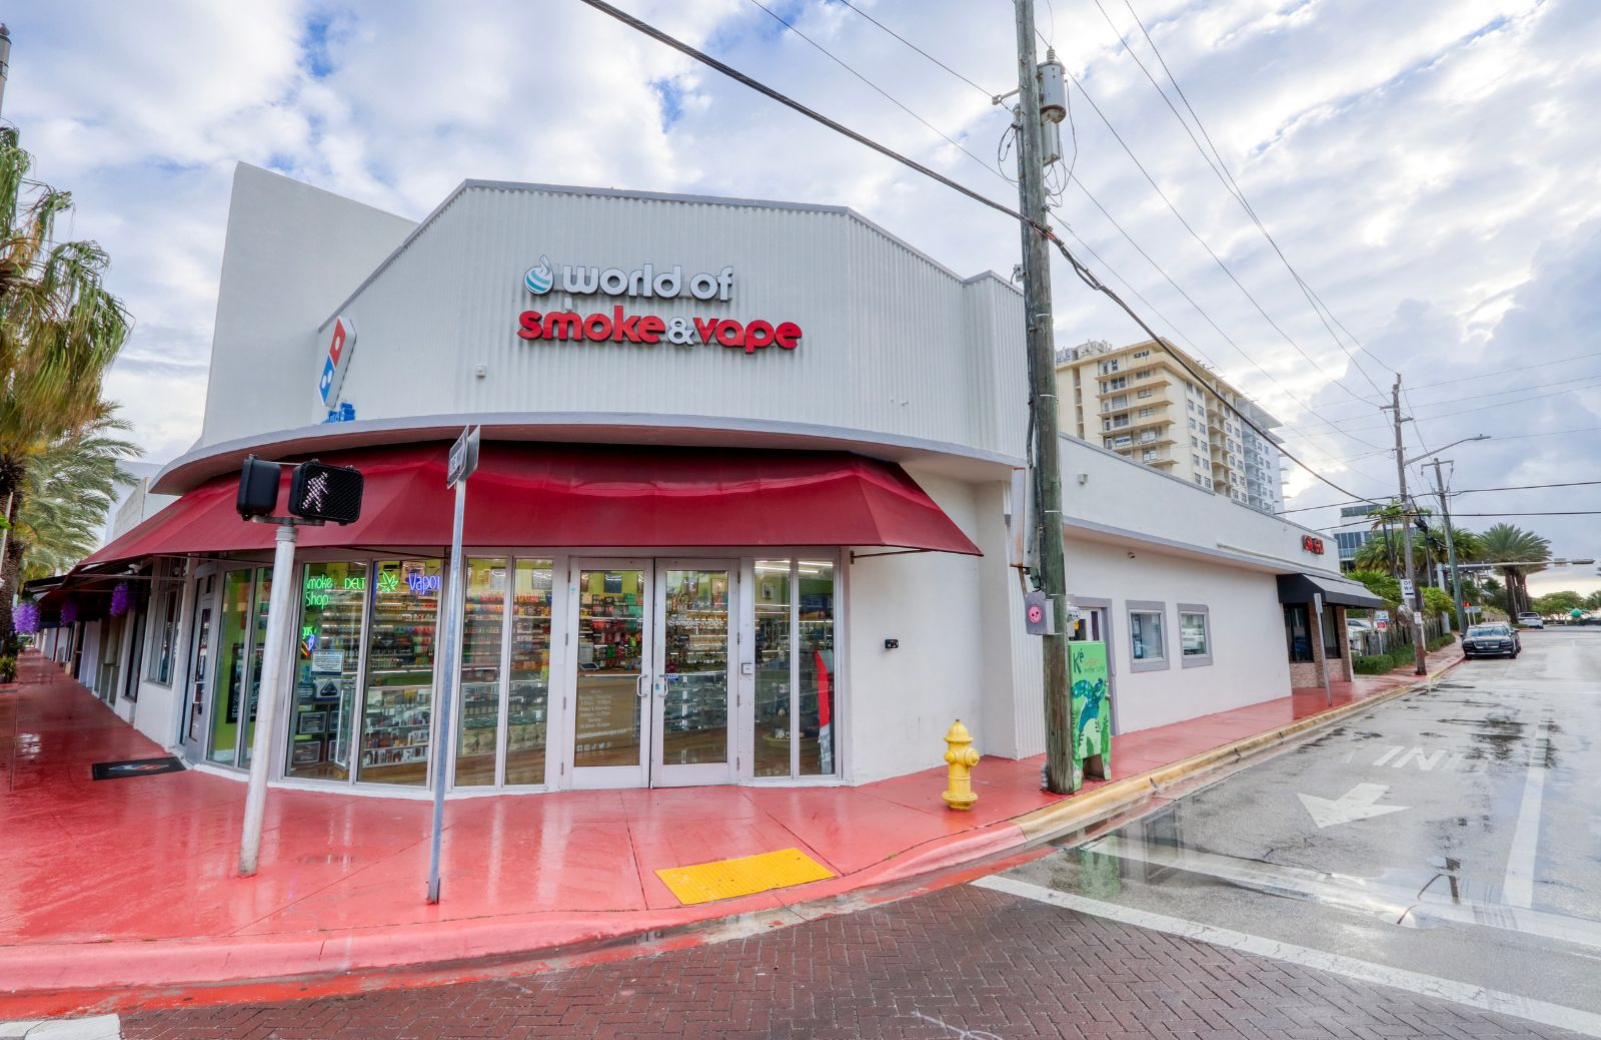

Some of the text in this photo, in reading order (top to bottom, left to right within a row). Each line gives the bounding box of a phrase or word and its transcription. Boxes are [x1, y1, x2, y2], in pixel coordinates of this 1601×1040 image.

[562, 263, 733, 301] world of
[305, 574, 333, 590] moke
[344, 577, 366, 590] DELT
[305, 591, 329, 610] Shop
